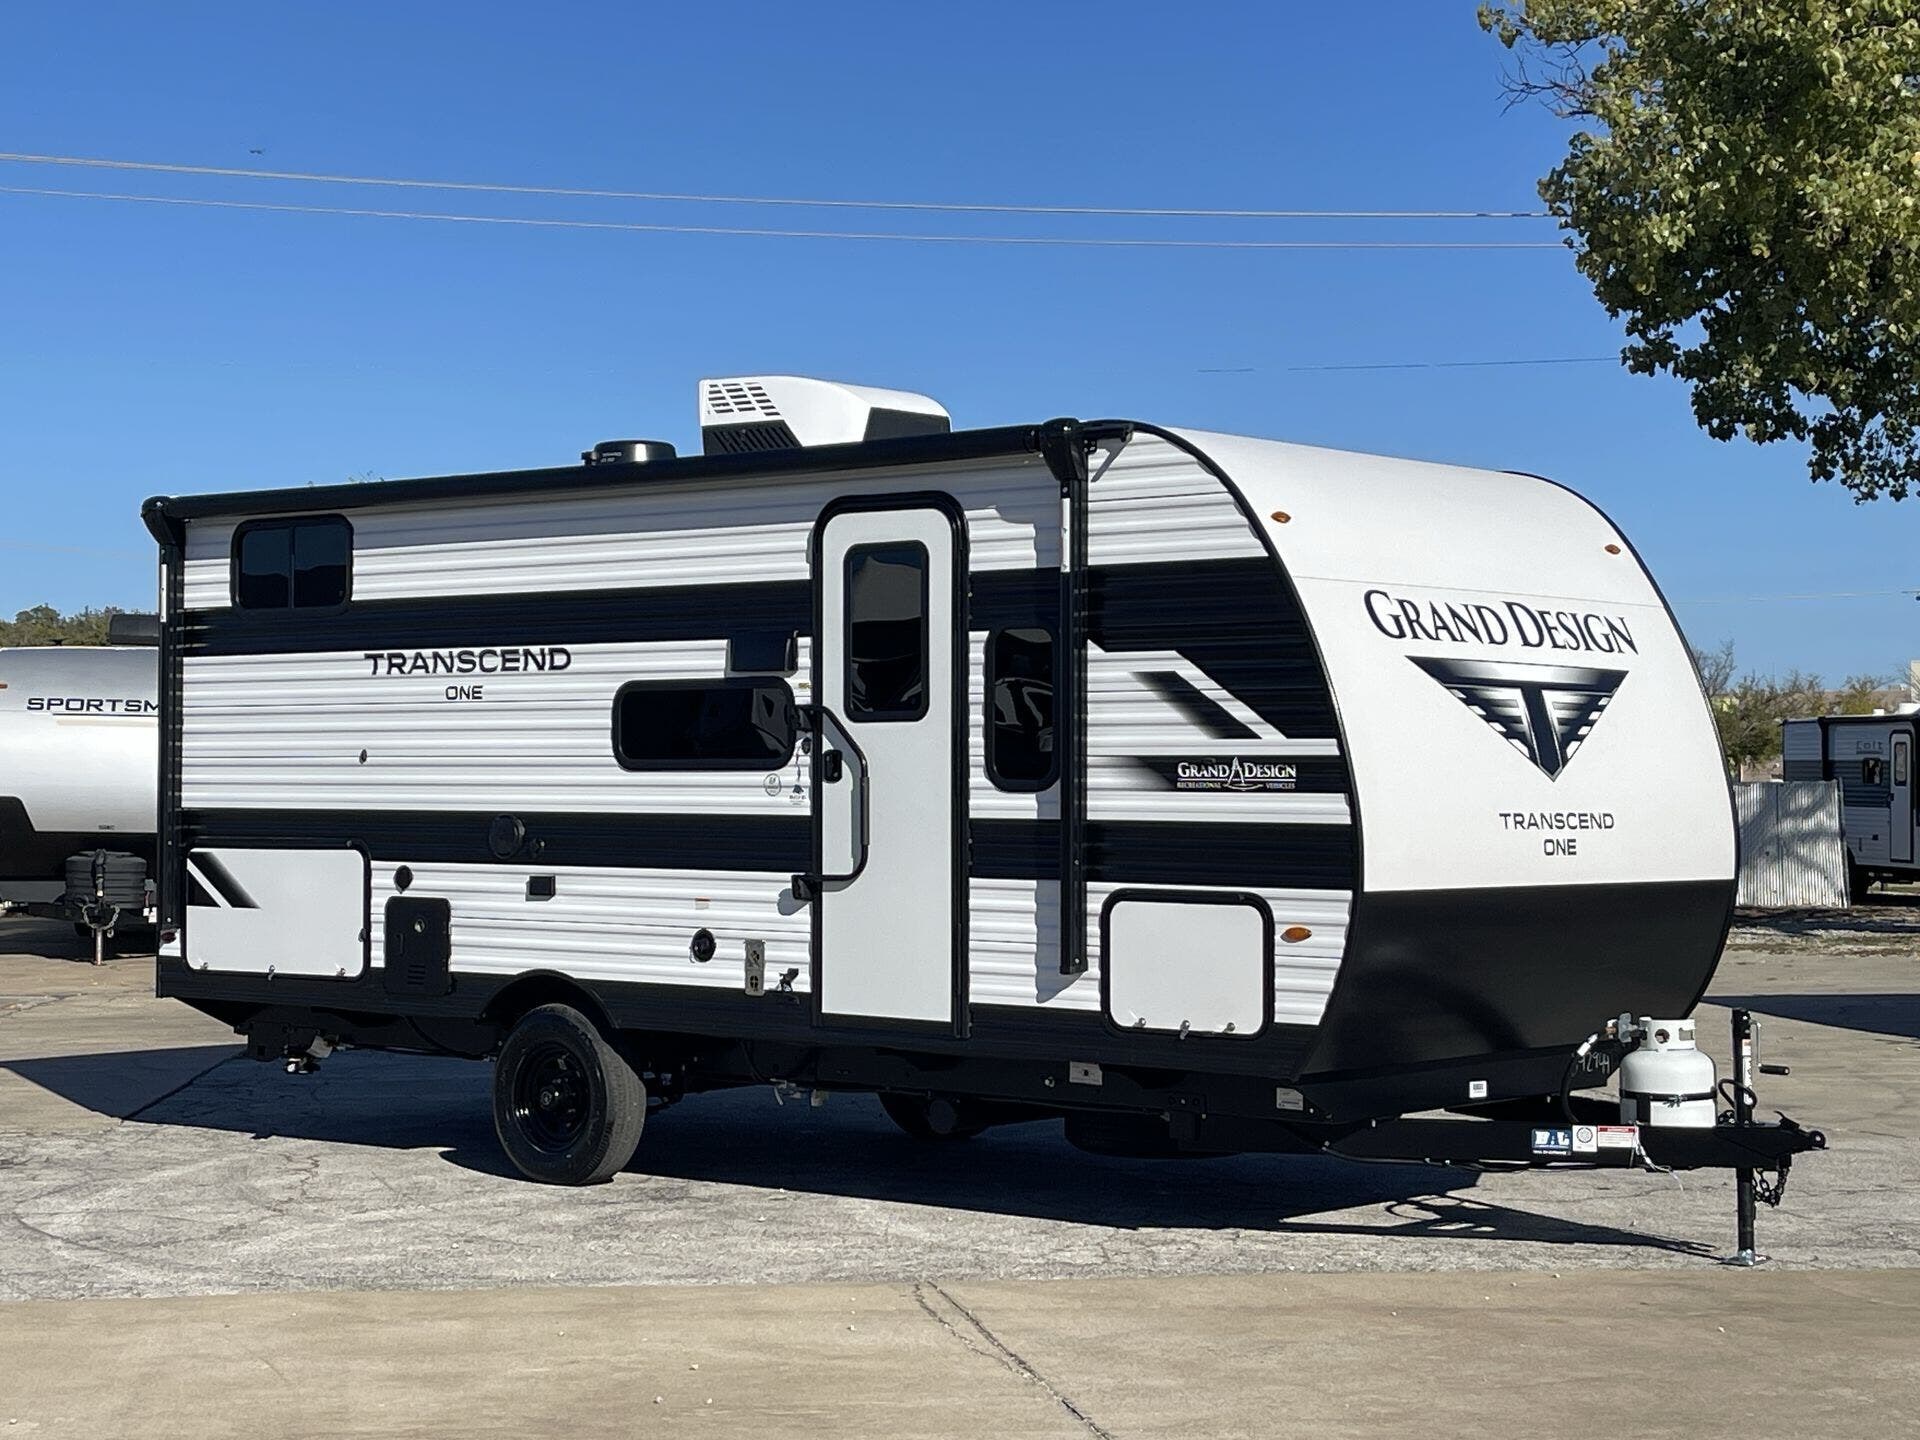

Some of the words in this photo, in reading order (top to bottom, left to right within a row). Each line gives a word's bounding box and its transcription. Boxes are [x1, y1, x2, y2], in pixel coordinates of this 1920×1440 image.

[1364, 589, 1508, 646] GRAND
[1502, 600, 1639, 656] DESIGN
[364, 646, 572, 676] TRANSCEND
[445, 684, 484, 701] ONE
[1176, 761, 1230, 779] GRAND
[1243, 762, 1298, 779] DESIGN
[1499, 812, 1615, 831] TRANSCEND
[1543, 838, 1578, 857] ONE
